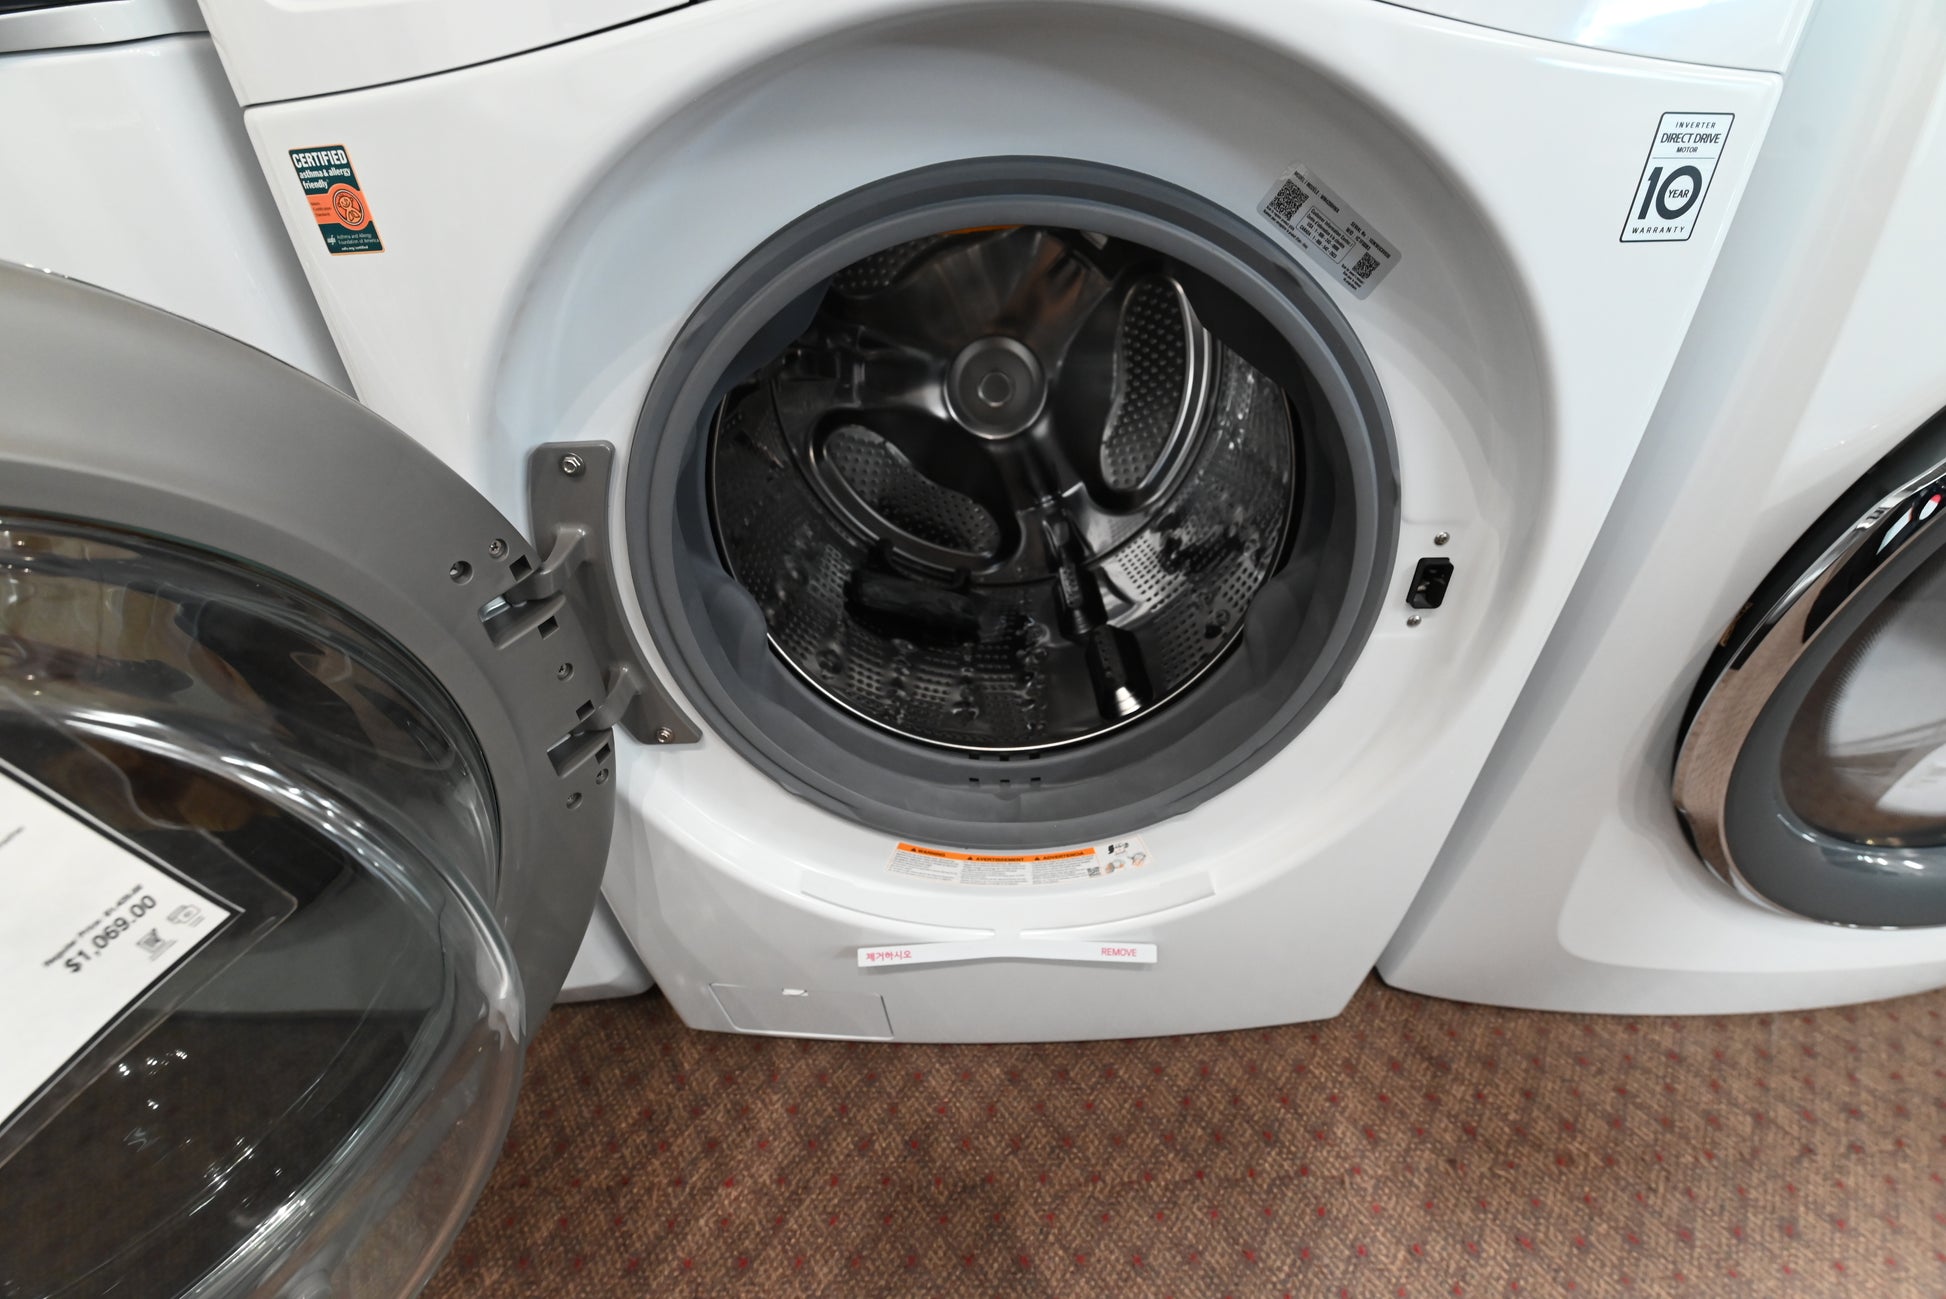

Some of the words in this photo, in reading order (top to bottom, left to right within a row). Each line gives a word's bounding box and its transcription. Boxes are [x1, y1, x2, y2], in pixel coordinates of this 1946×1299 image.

[1675, 121, 1716, 129] INVERTER
[1660, 132, 1694, 144] DIRECT
[1693, 133, 1721, 144] DRIVE
[292, 150, 348, 168] CERTIFIED
[299, 169, 323, 178] asthma
[323, 169, 328, 177] &
[328, 167, 351, 177] allergy
[303, 179, 328, 189] friendly
[1637, 165, 1702, 220] 10
[1667, 189, 1690, 199] YEAR
[1631, 226, 1685, 234] WARRANTY
[64, 894, 157, 973] $1,069.00
[866, 949, 912, 961] 제거하시오
[1101, 947, 1137, 957] REMOVE
